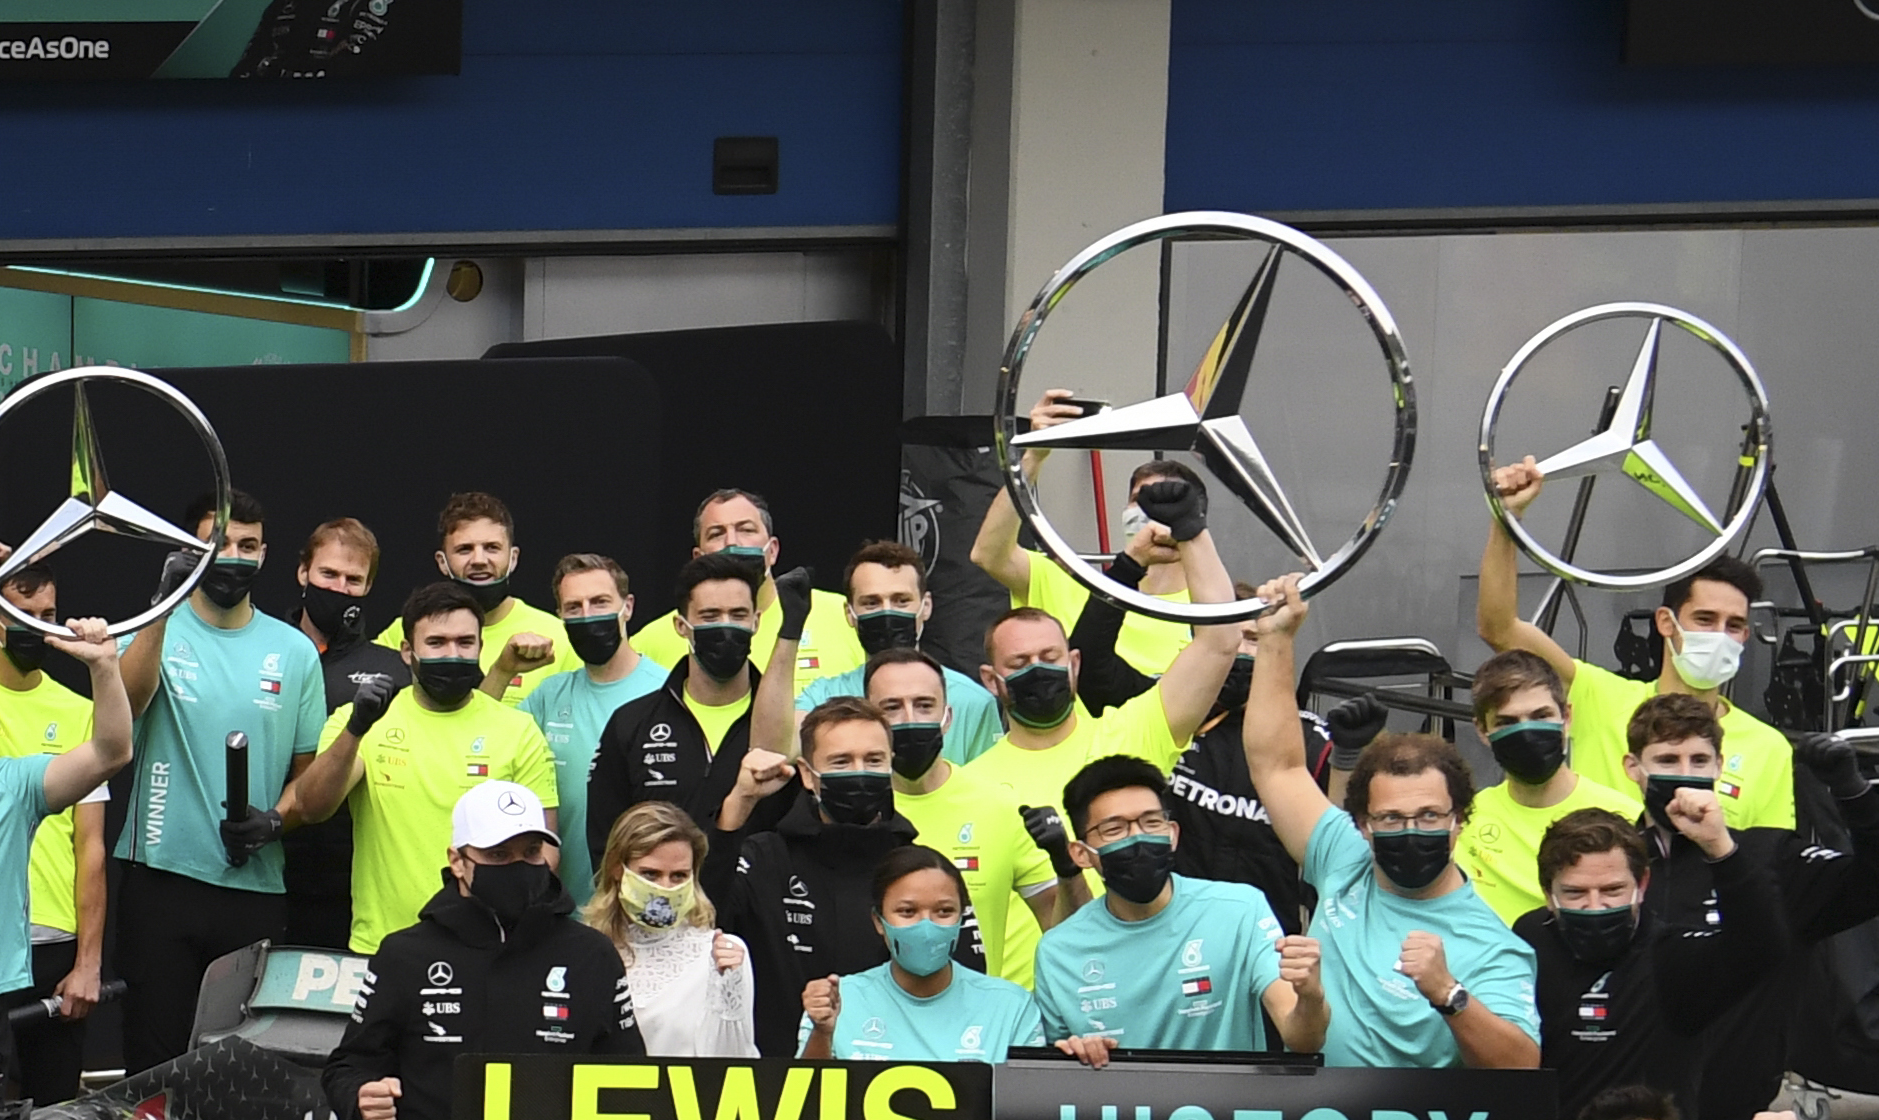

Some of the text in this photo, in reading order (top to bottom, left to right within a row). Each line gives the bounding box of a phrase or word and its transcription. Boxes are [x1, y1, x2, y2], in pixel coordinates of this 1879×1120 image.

[388, 756, 407, 767] UBS
[655, 753, 676, 762] UBS
[146, 761, 171, 846] WINNER
[1165, 774, 1272, 826] ETRONA
[793, 913, 812, 924] UBS
[436, 1002, 461, 1014] UBS
[1095, 998, 1117, 1010] UBS
